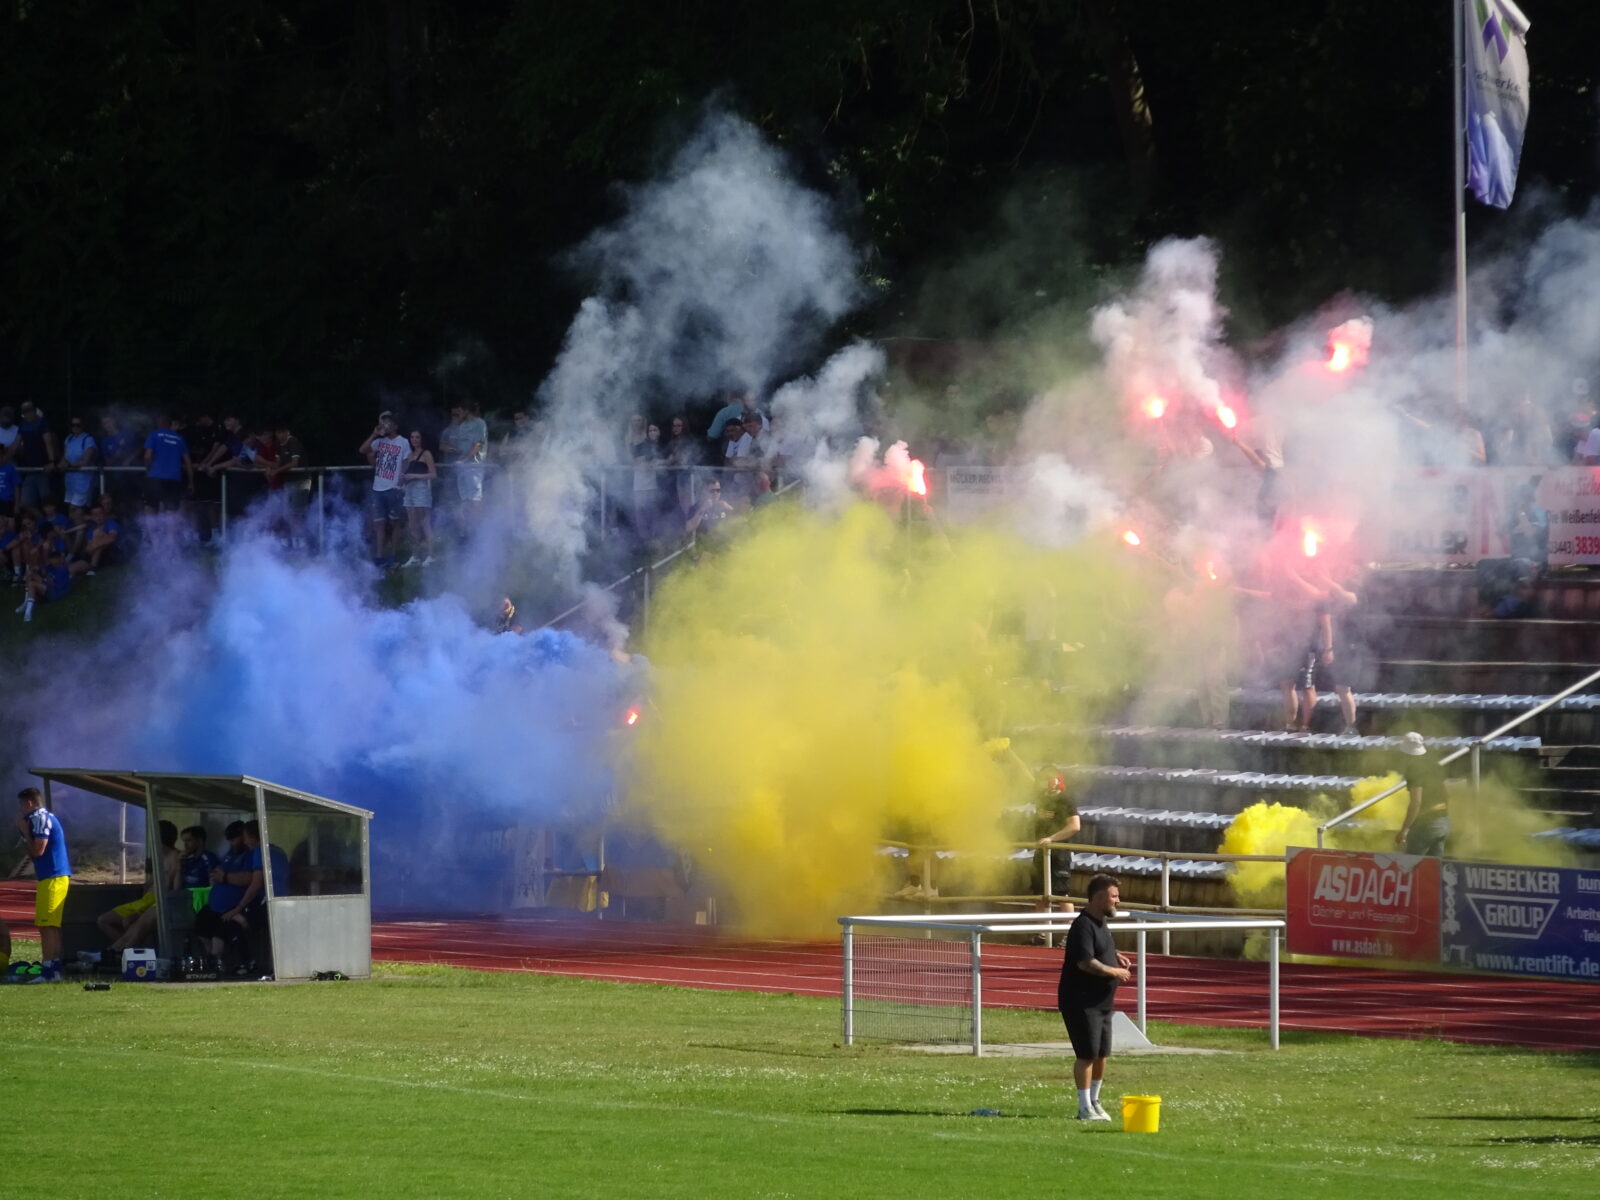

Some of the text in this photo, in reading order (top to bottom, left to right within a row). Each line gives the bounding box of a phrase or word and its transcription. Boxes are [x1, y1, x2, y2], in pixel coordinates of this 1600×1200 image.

[1313, 864, 1414, 907] ASDACH
[1465, 867, 1560, 894] WIESECKER
[1484, 903, 1545, 929] GROUP
[1475, 953, 1599, 978] www.rentlift.de
